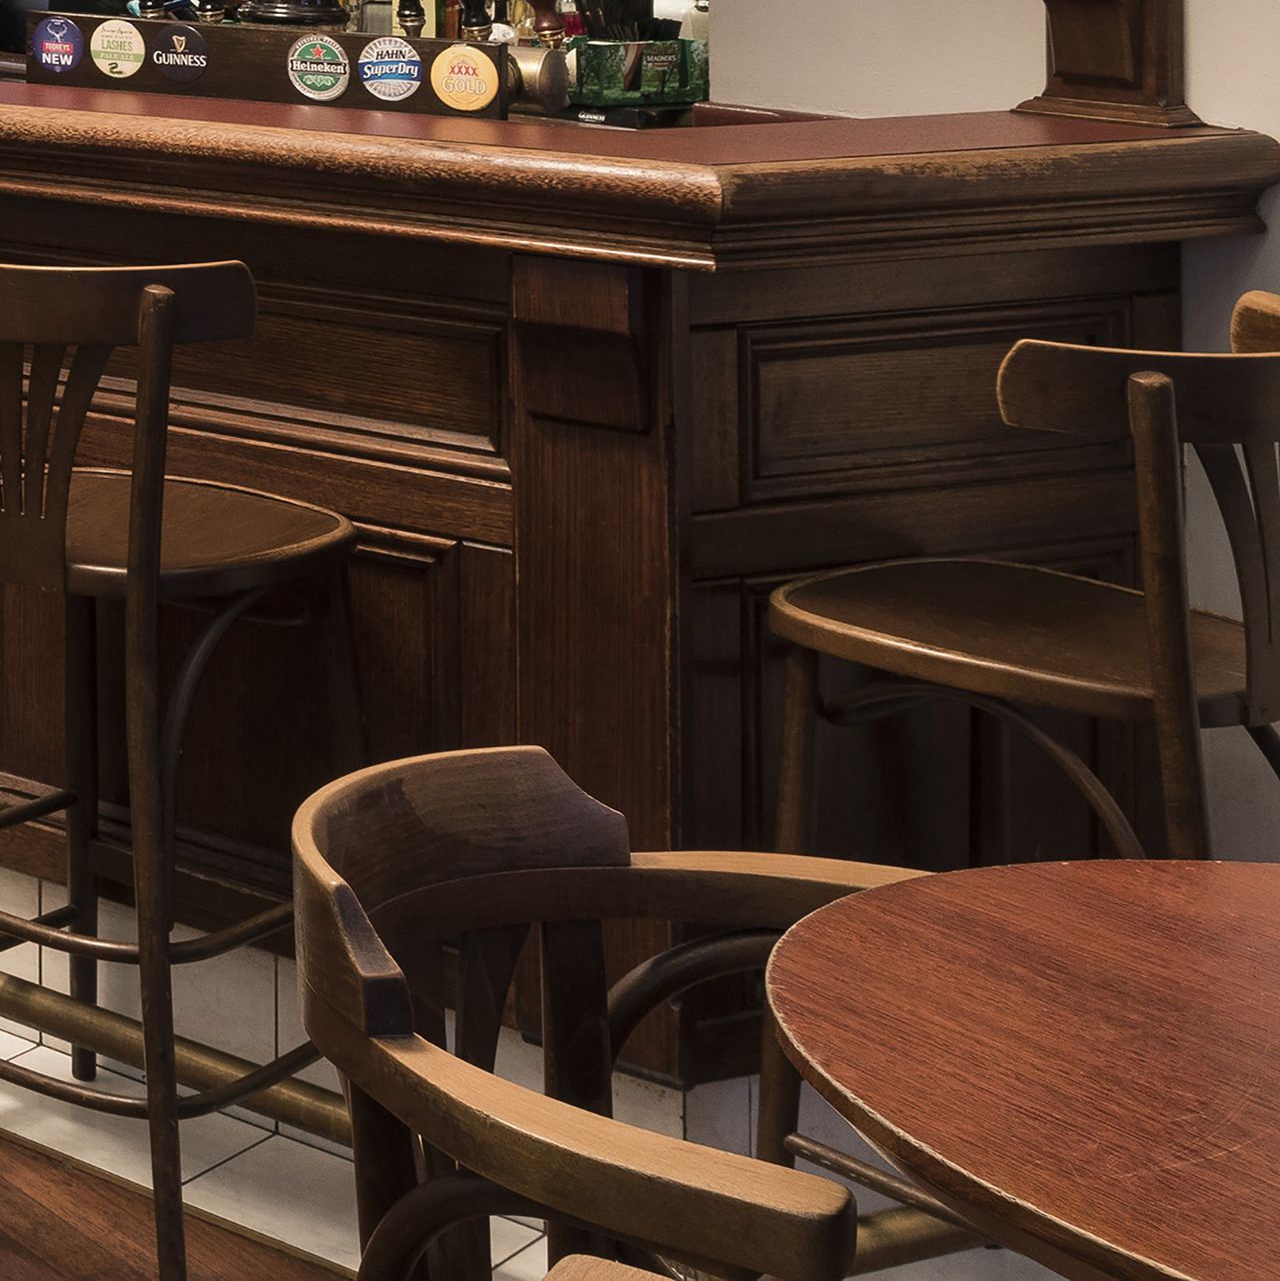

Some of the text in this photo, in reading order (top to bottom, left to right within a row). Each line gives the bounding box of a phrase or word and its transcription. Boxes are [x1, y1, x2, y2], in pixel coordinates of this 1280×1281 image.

[45, 42, 71, 52] TOOHEYS
[101, 38, 133, 52] LASHES
[42, 53, 73, 66] NEW
[153, 50, 207, 67] GUINNESS
[375, 49, 407, 61] HAHN
[647, 55, 677, 63] MAGNERS
[291, 59, 346, 74] Heineken
[363, 63, 419, 80] SuperDry
[448, 65, 479, 77] XXXX
[441, 78, 487, 96] GOLD
[578, 111, 606, 121] GUINNESS
